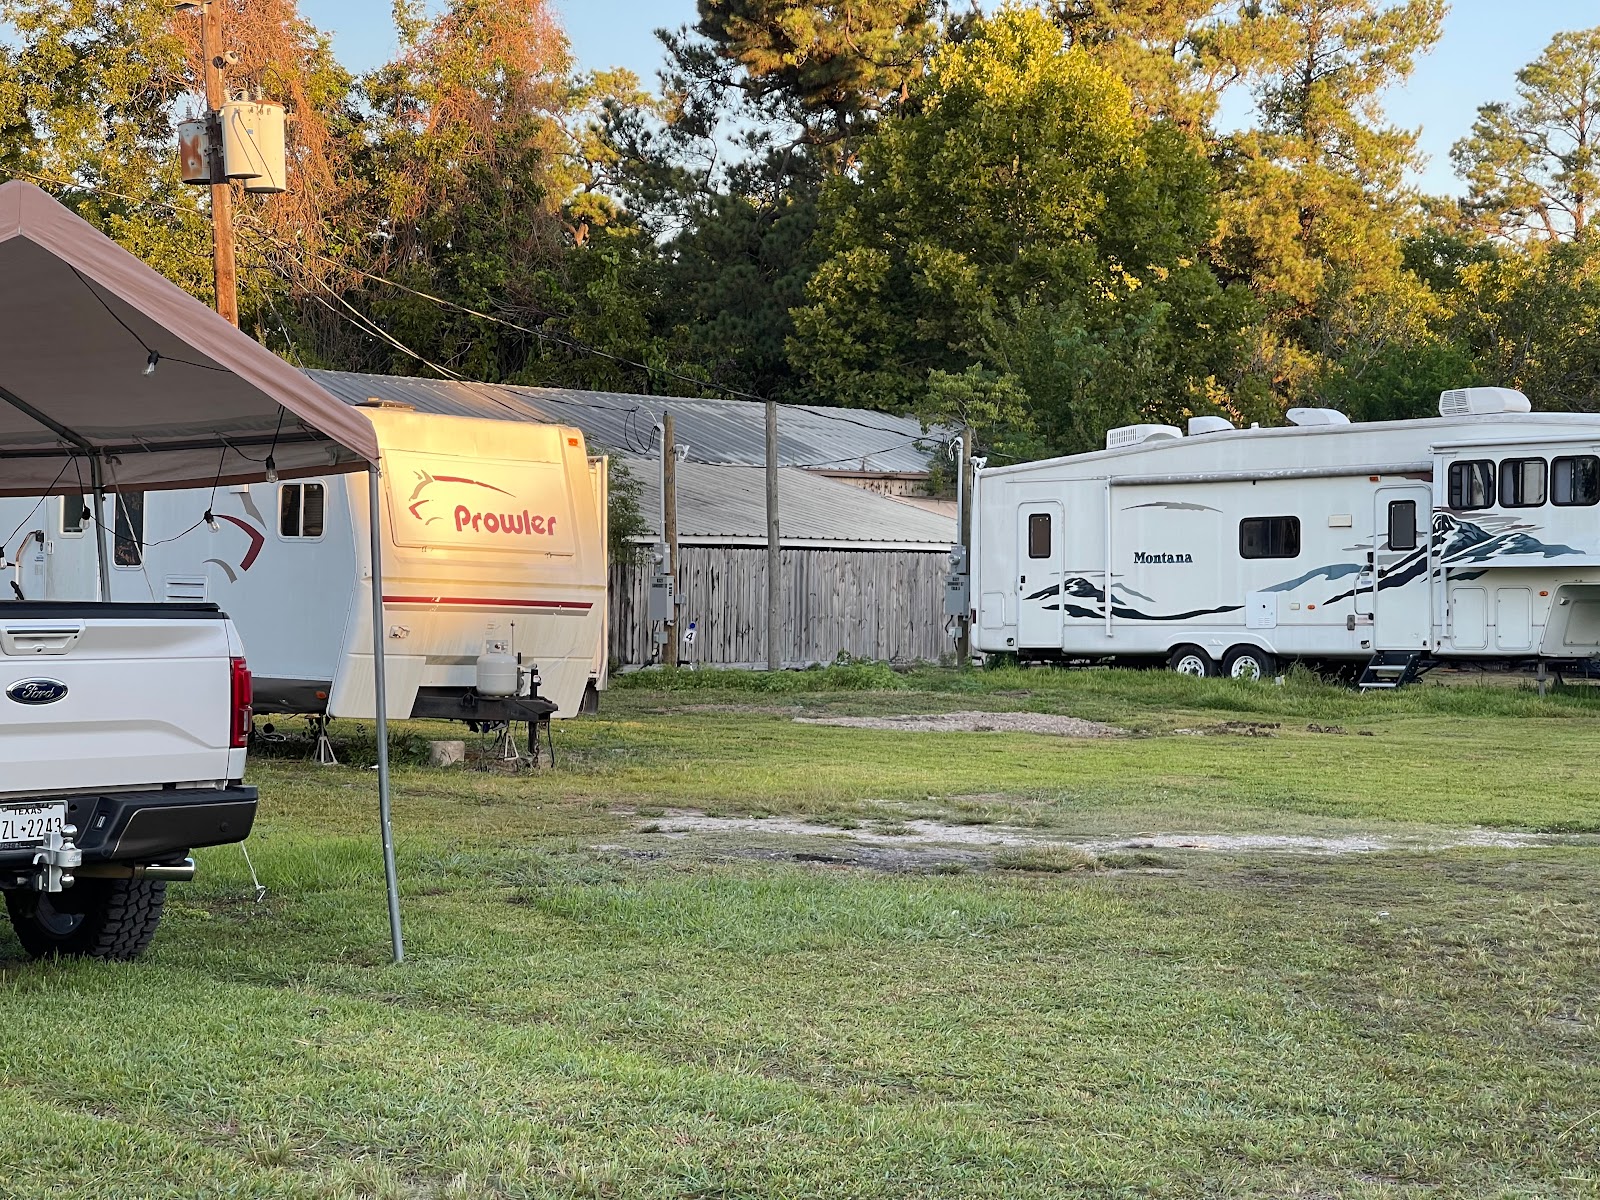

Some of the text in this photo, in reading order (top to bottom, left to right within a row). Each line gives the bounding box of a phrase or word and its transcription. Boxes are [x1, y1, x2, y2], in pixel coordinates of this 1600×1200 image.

[453, 504, 558, 536] Prowler
[1133, 551, 1193, 564] Montana
[685, 632, 694, 642] 4
[22, 682, 56, 699] Ford
[13, 807, 43, 816] TEXAS
